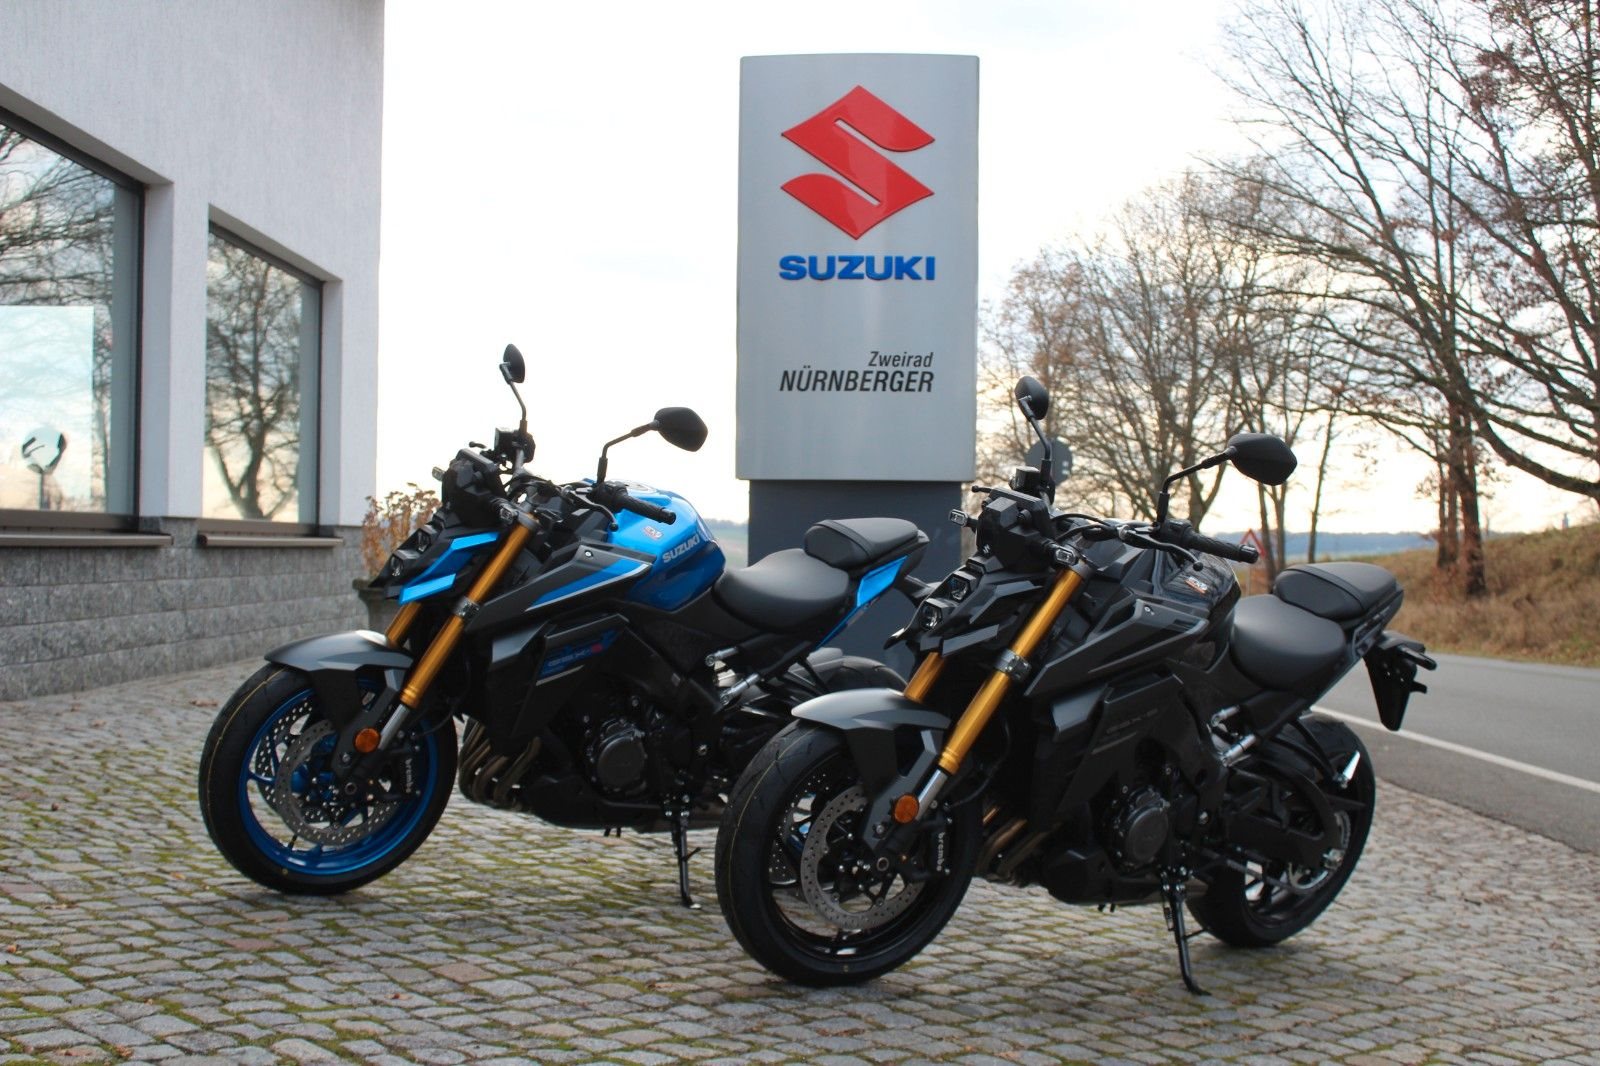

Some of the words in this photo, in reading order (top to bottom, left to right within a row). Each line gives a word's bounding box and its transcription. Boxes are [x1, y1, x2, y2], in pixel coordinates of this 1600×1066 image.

[779, 255, 936, 281] SUZUKI
[868, 351, 934, 367] Zweirad
[779, 365, 934, 392] NÜRNBERGER
[662, 534, 701, 563] SUZUKI
[936, 832, 945, 872] brembo
